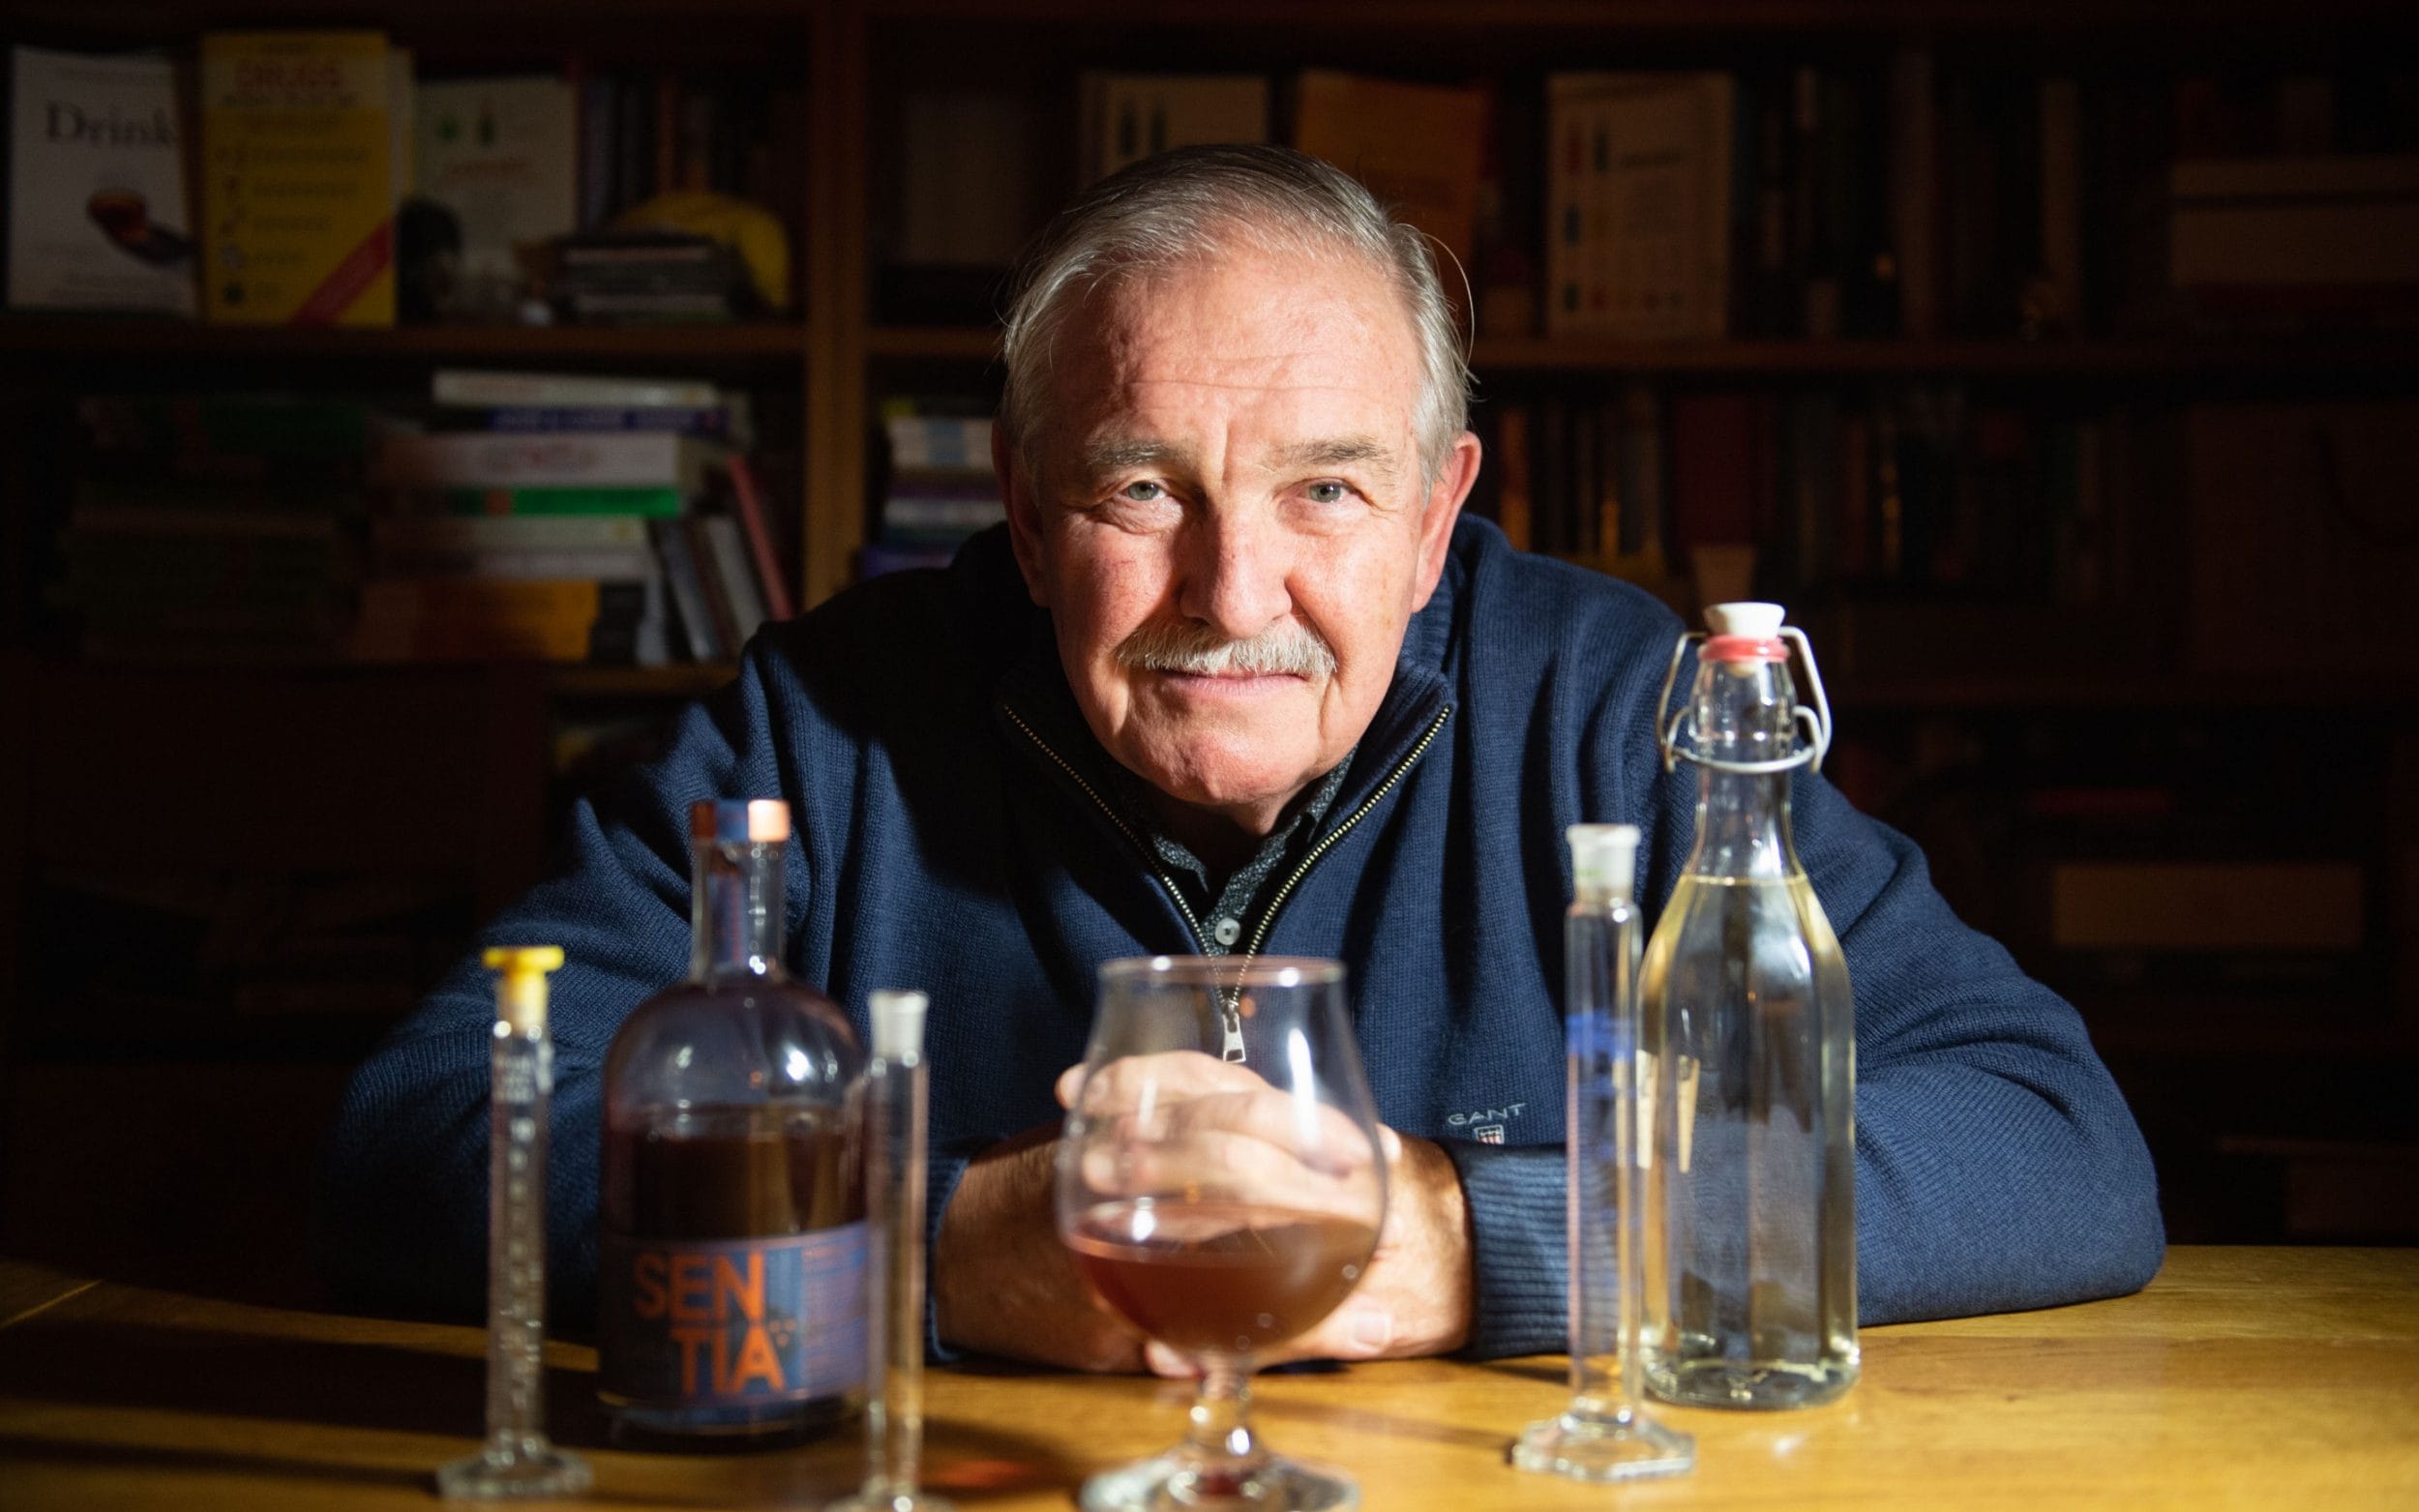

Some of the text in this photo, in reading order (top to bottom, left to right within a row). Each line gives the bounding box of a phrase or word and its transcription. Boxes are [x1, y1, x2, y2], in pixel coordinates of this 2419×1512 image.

[1448, 1103, 1526, 1125] GANT
[634, 1250, 765, 1322] SEN
[671, 1323, 787, 1394] TIA
